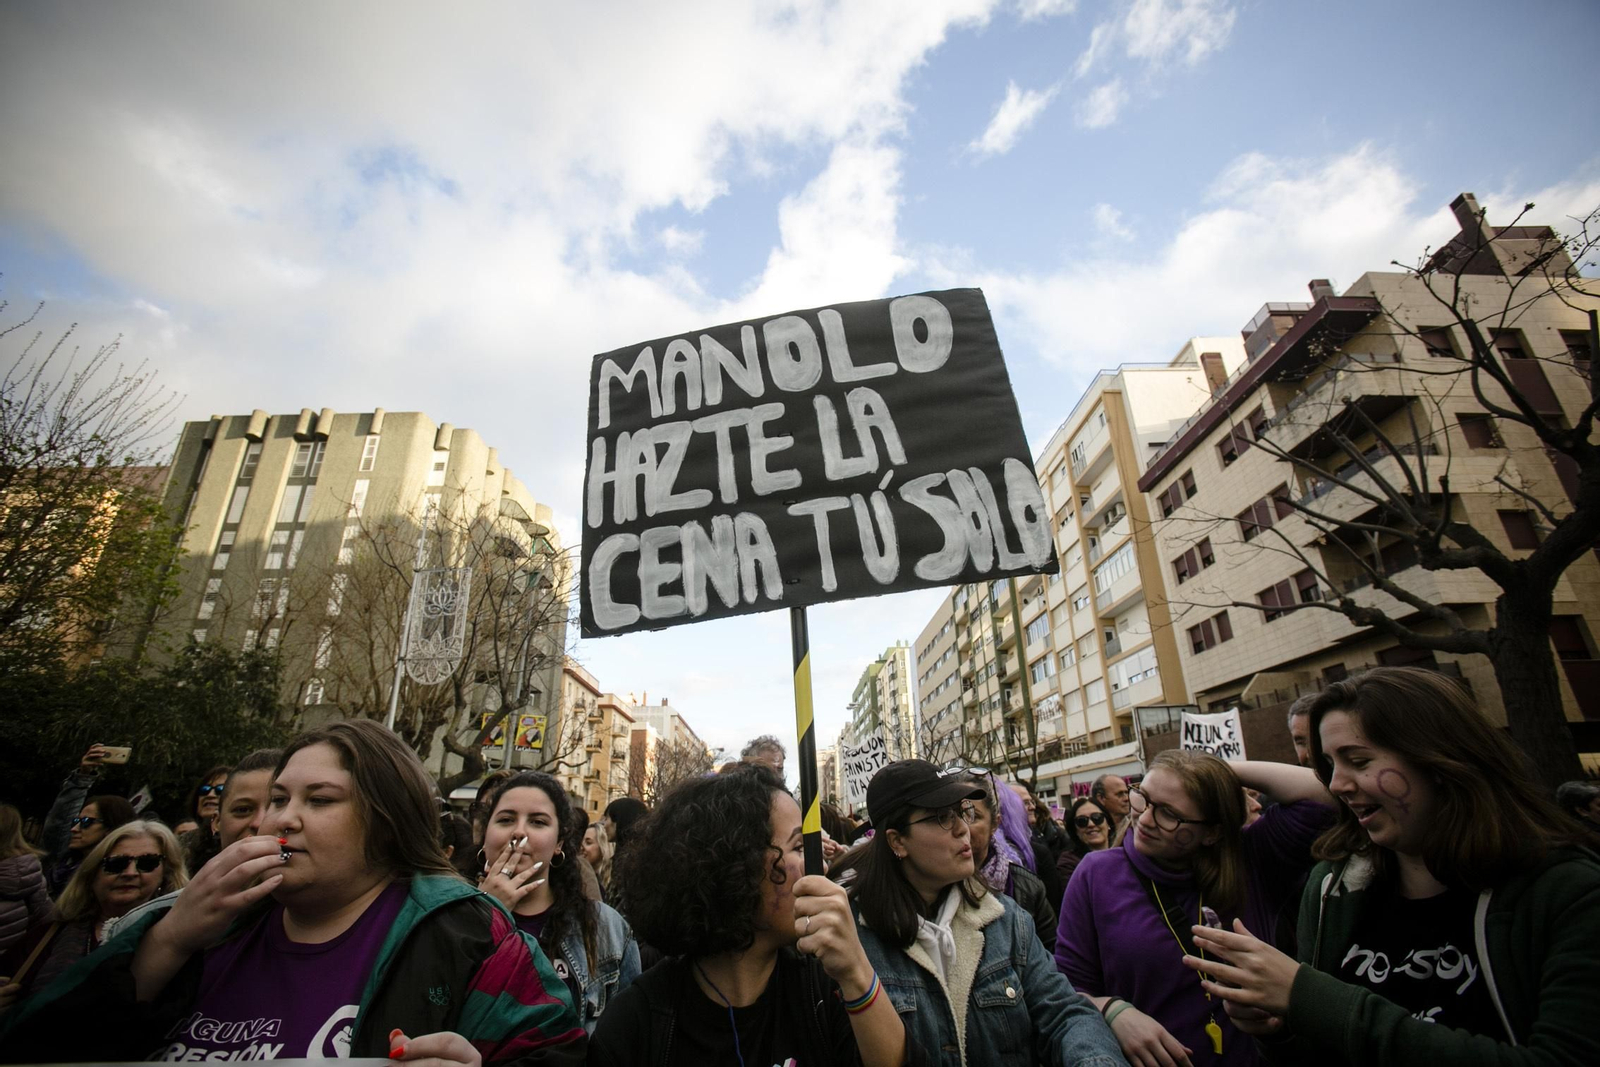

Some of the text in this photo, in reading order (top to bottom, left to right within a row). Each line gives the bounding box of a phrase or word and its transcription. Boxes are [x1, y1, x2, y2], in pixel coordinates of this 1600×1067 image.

[597, 295, 953, 429] MANOLO
[587, 386, 908, 528] HAZTE LA
[589, 457, 1053, 630] CENA TÚ SOLO
[1184, 721, 1223, 744] NI UN
[1341, 943, 1391, 984] no
